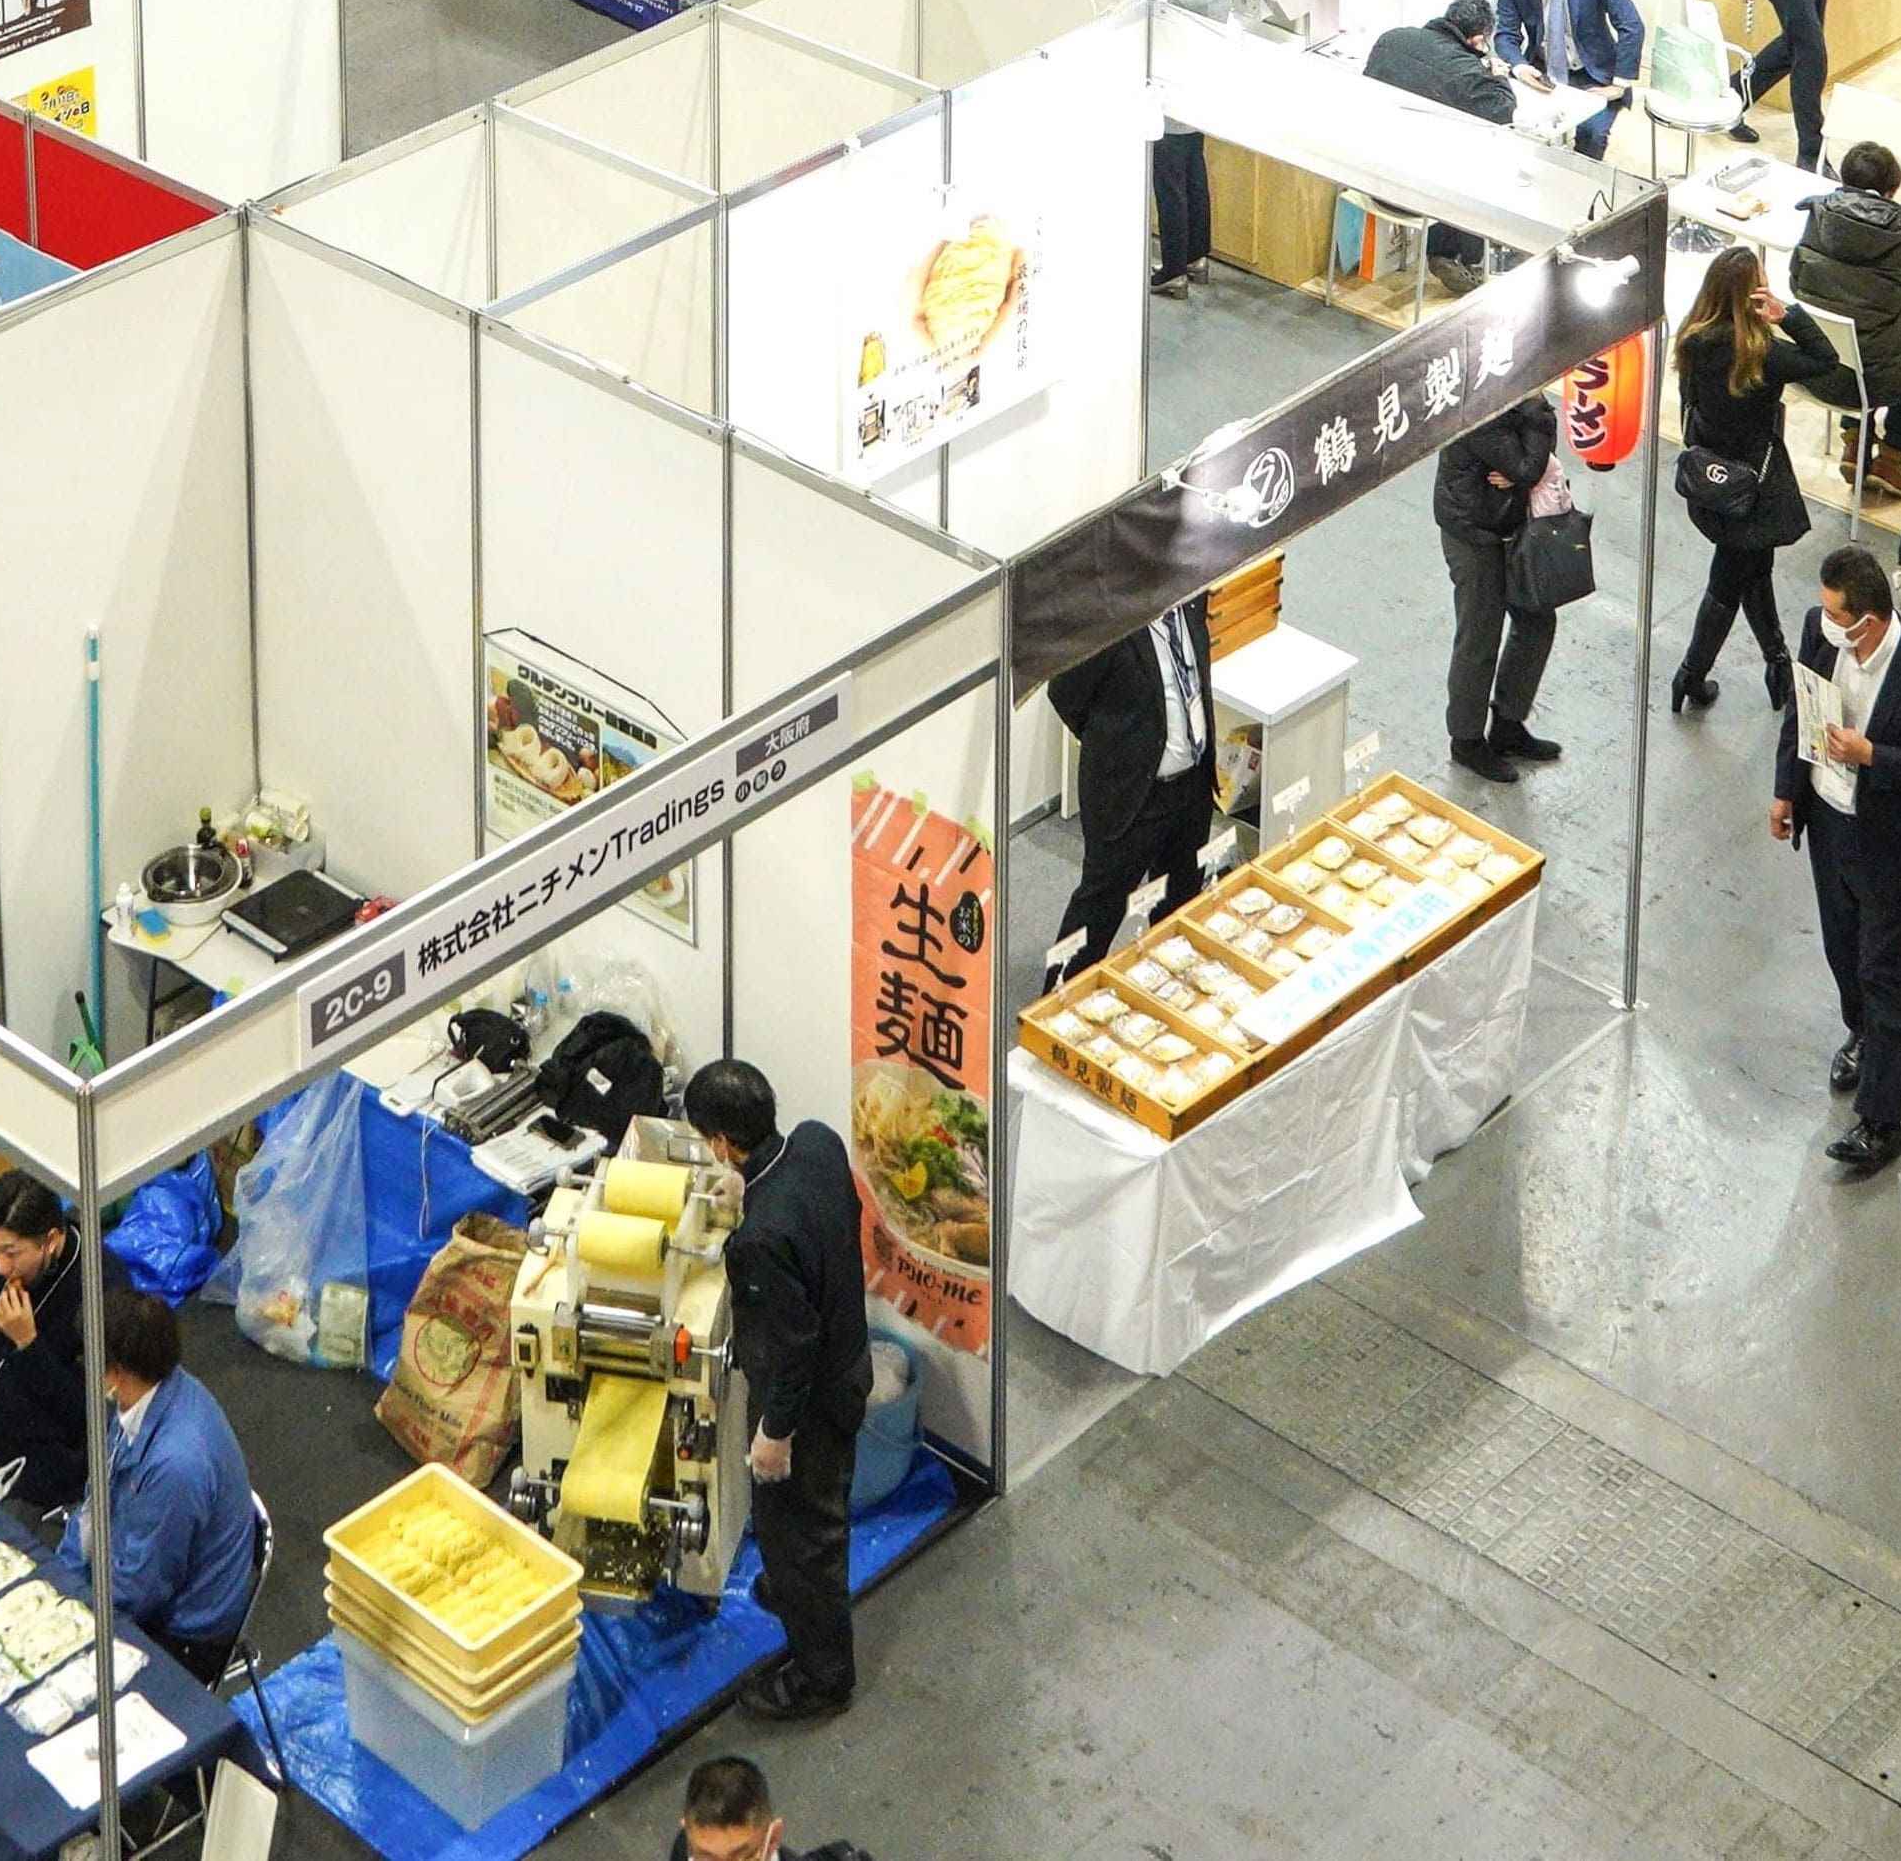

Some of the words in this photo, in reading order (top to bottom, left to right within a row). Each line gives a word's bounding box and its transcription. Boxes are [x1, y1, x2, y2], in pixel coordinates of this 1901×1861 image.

[324, 968, 393, 1030] 2C-9
[416, 777, 726, 977] 株式会社ニチメンTradings
[764, 714, 812, 757] 大阪府
